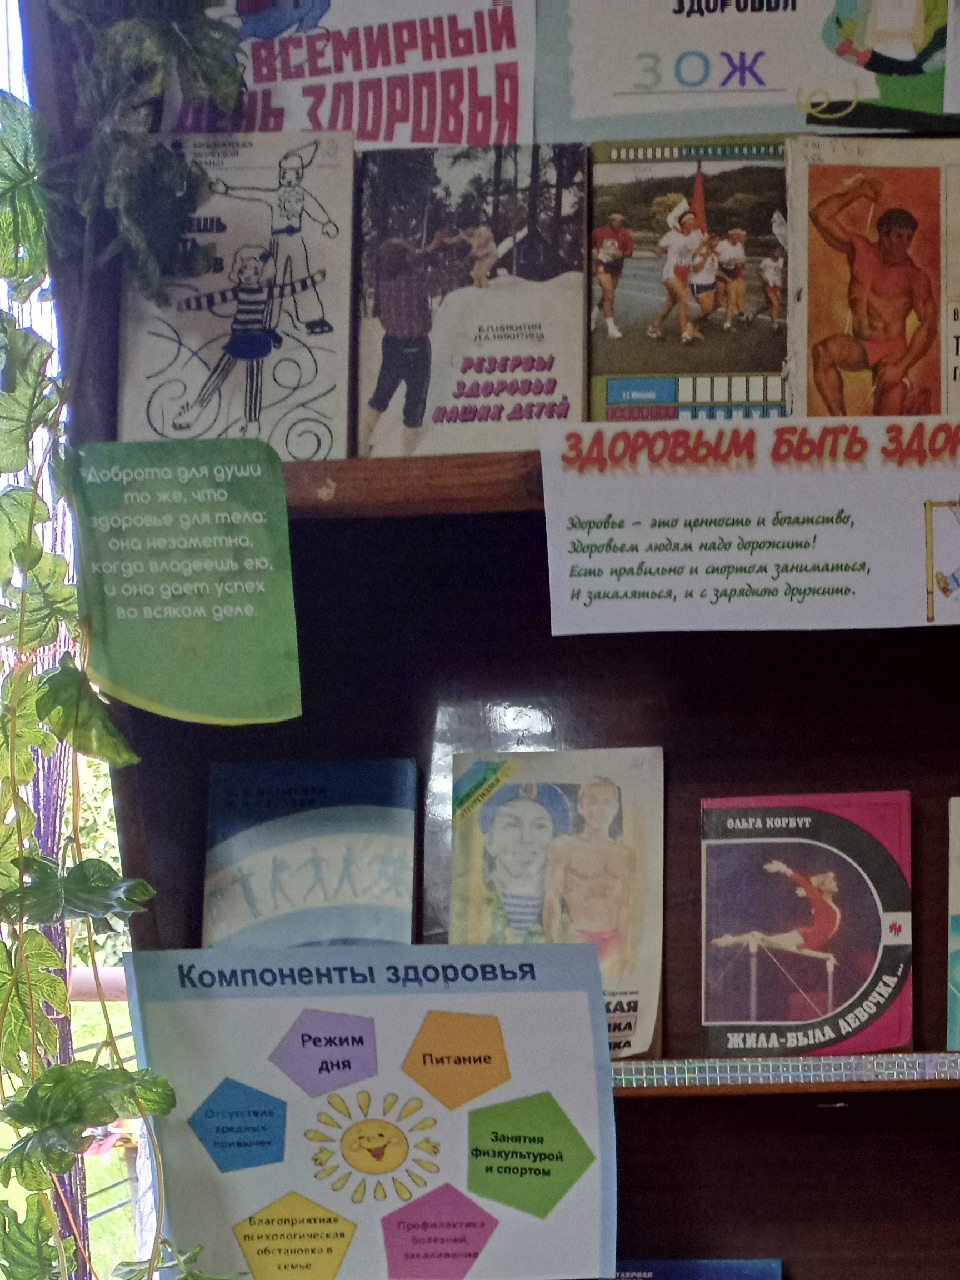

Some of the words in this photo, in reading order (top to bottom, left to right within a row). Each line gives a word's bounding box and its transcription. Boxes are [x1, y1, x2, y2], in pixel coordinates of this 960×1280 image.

[252, 6, 516, 83] ВСЕМИРНЫЙ
[302, 61, 518, 146] ЗДОРОВЬЯ
[461, 356, 554, 373] РЕЗЕРВЫ
[453, 378, 557, 399] ЗДОРОВЬЯ
[432, 404, 504, 422] НАШИХ
[506, 394, 570, 421] ДЕТЕЙ
[561, 428, 757, 473] ЗДОРОВЫМ
[771, 426, 868, 464] БЫТЬ
[177, 466, 208, 484] для
[214, 463, 261, 482] души
[192, 488, 228, 501] что
[179, 513, 210, 529] для
[566, 513, 625, 536] Здоровье
[683, 517, 752, 532] ценность
[772, 509, 854, 529] богатство,
[568, 537, 639, 558] Здоровьем
[699, 536, 732, 551] надо
[92, 561, 144, 577] когда
[150, 558, 239, 576] владеешь
[215, 581, 265, 597] успех
[143, 606, 206, 619] всяком
[727, 817, 763, 829] ОЛЬГА
[766, 816, 812, 829] КОРБУТ
[178, 963, 376, 990] Компоненты
[386, 961, 537, 985] здоровья
[300, 1034, 365, 1050] Режим
[726, 1024, 835, 1051] ЖИЛА-БЫЛА
[317, 1058, 352, 1076] дня
[422, 1052, 492, 1067] Питание
[490, 1131, 545, 1145] Занятия
[497, 1164, 551, 1179] спортом
